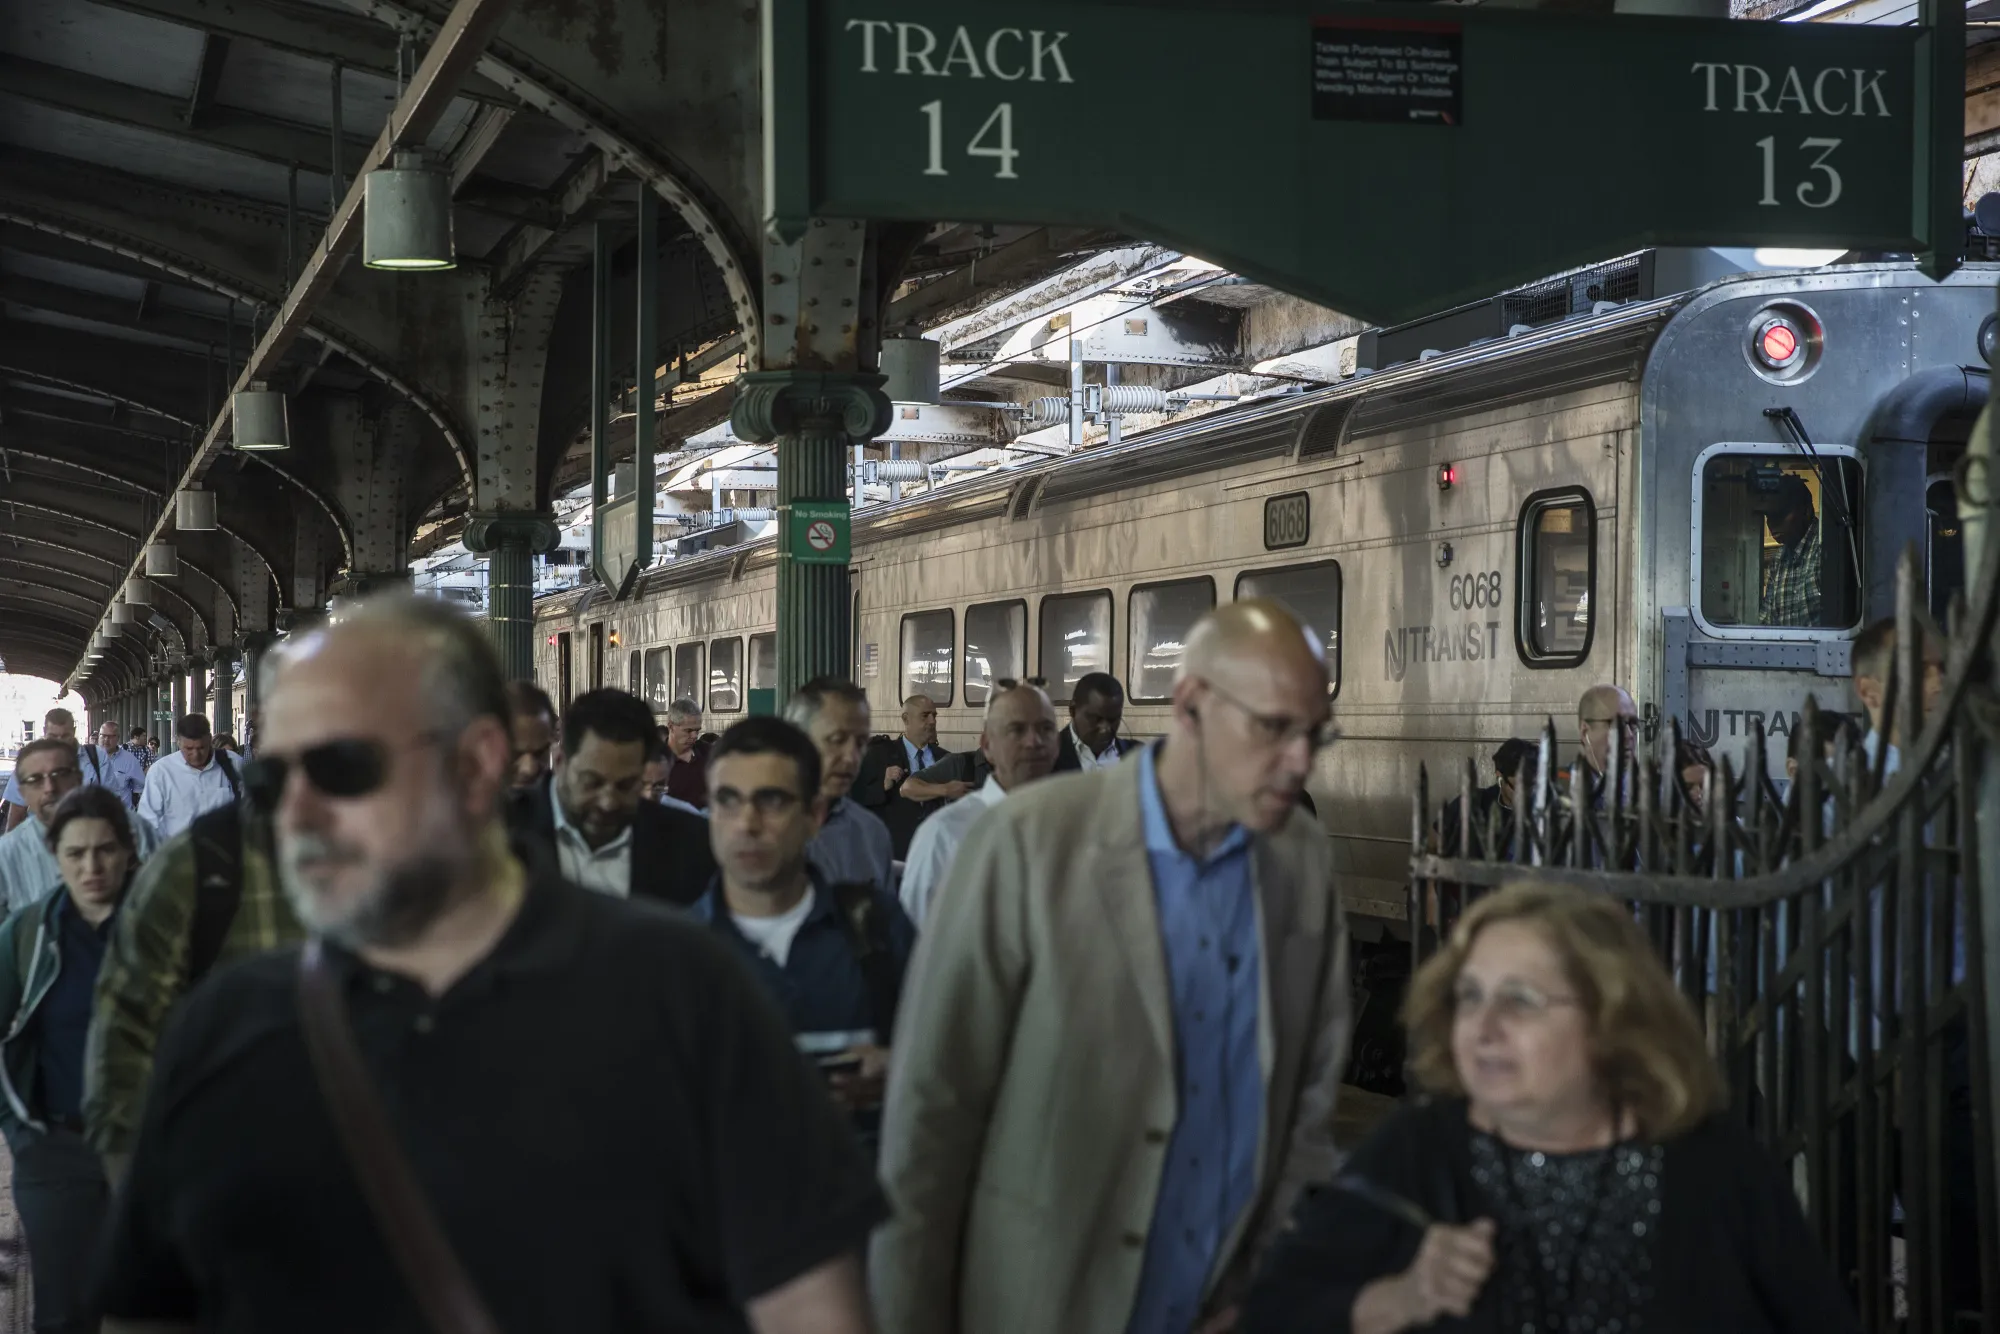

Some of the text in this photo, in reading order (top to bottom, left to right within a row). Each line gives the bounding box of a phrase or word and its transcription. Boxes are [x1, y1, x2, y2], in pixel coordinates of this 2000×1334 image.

[845, 19, 1074, 83] TRACK
[1315, 42, 1349, 53] Tickets
[1351, 43, 1402, 56] Purchased
[1342, 56, 1378, 70] Subject
[1315, 82, 1354, 96] Vending
[1356, 83, 1397, 95] Machine
[1377, 72, 1404, 84] Agent
[1691, 62, 1891, 117] TRACK
[920, 99, 1019, 178] 14
[1756, 135, 1842, 207] 13
[795, 509, 848, 521] No Smoking
[1269, 499, 1305, 543] 6068
[1450, 570, 1502, 611] 6068
